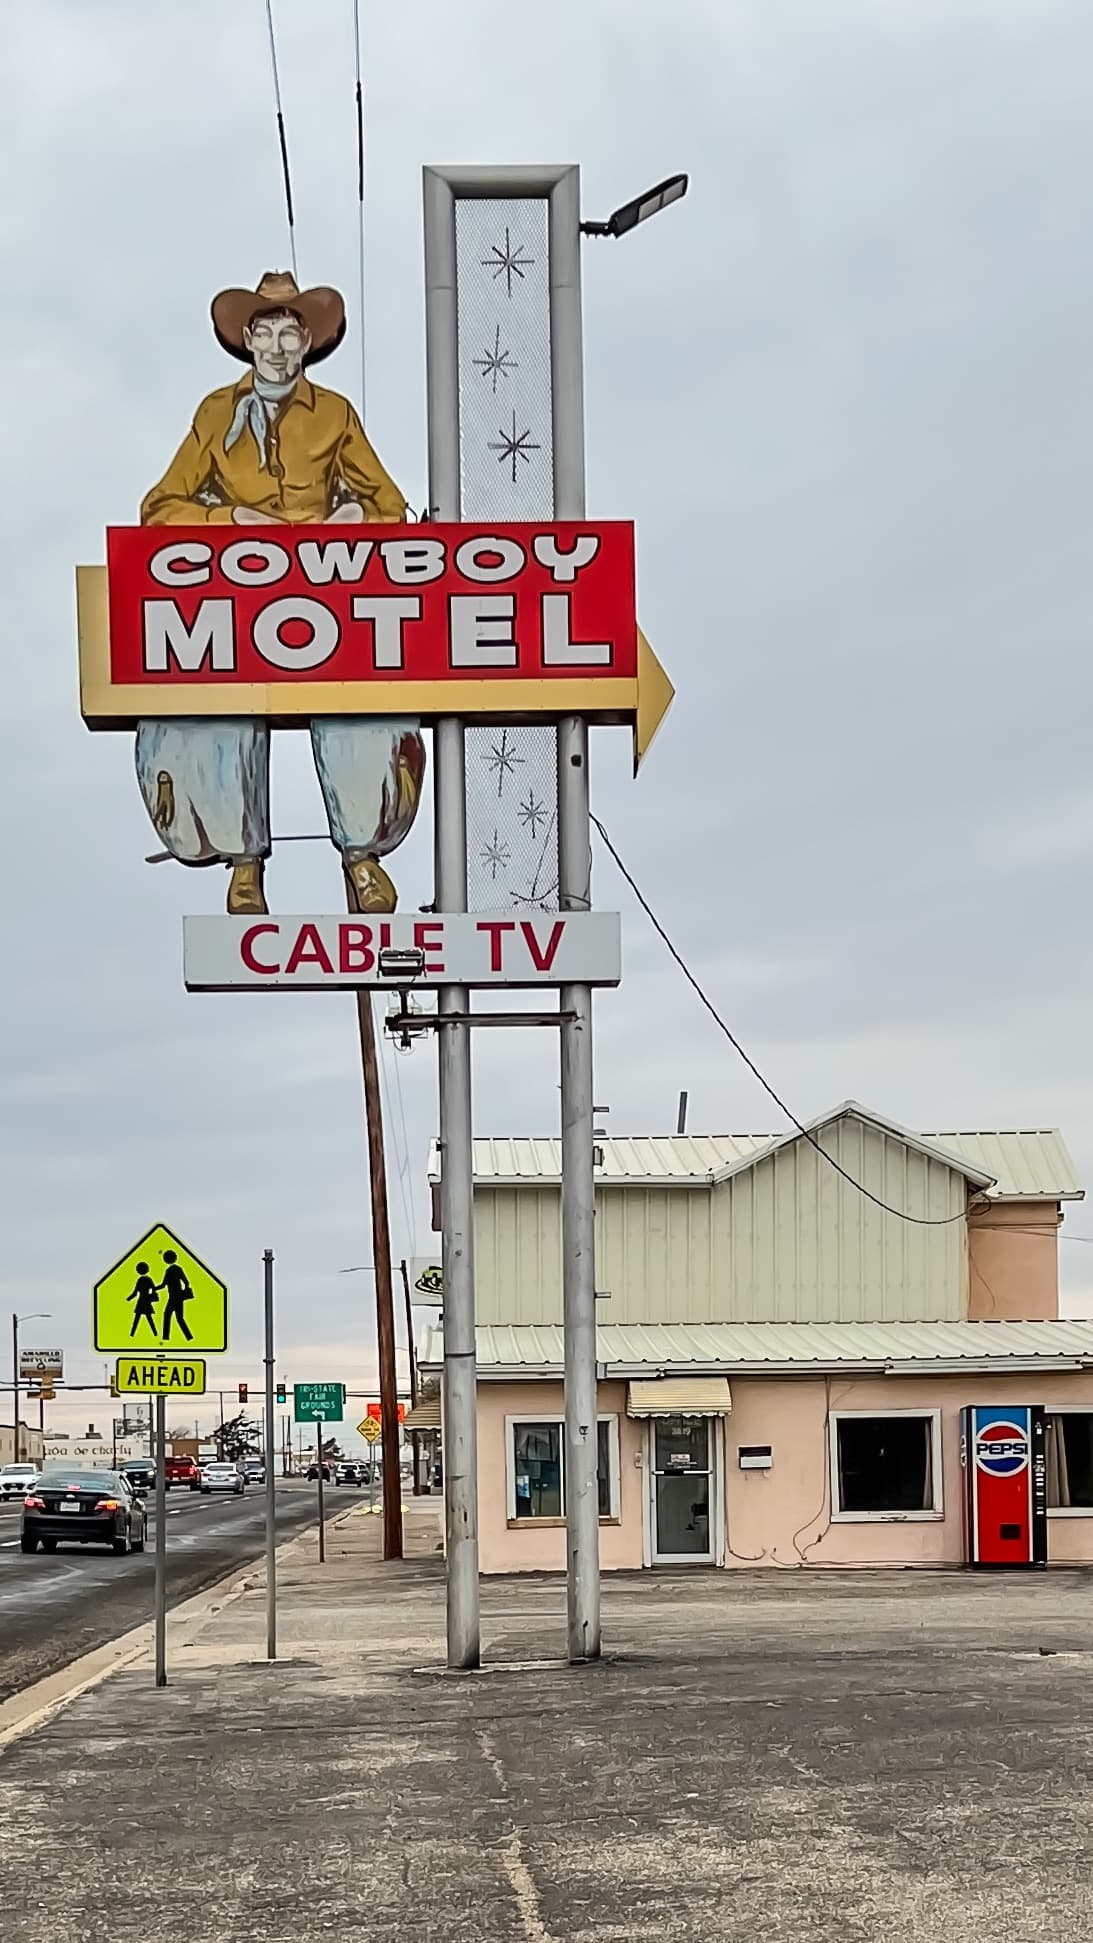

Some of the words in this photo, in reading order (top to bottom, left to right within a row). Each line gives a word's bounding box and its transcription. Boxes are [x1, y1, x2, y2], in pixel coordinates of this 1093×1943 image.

[149, 535, 600, 587] COWBOY
[143, 594, 612, 672] MOTEL
[476, 921, 566, 972] TV
[127, 1365, 195, 1387] AHEAD
[300, 1401, 336, 1409] GROUNDS
[976, 1442, 1028, 1455] PEPSI
